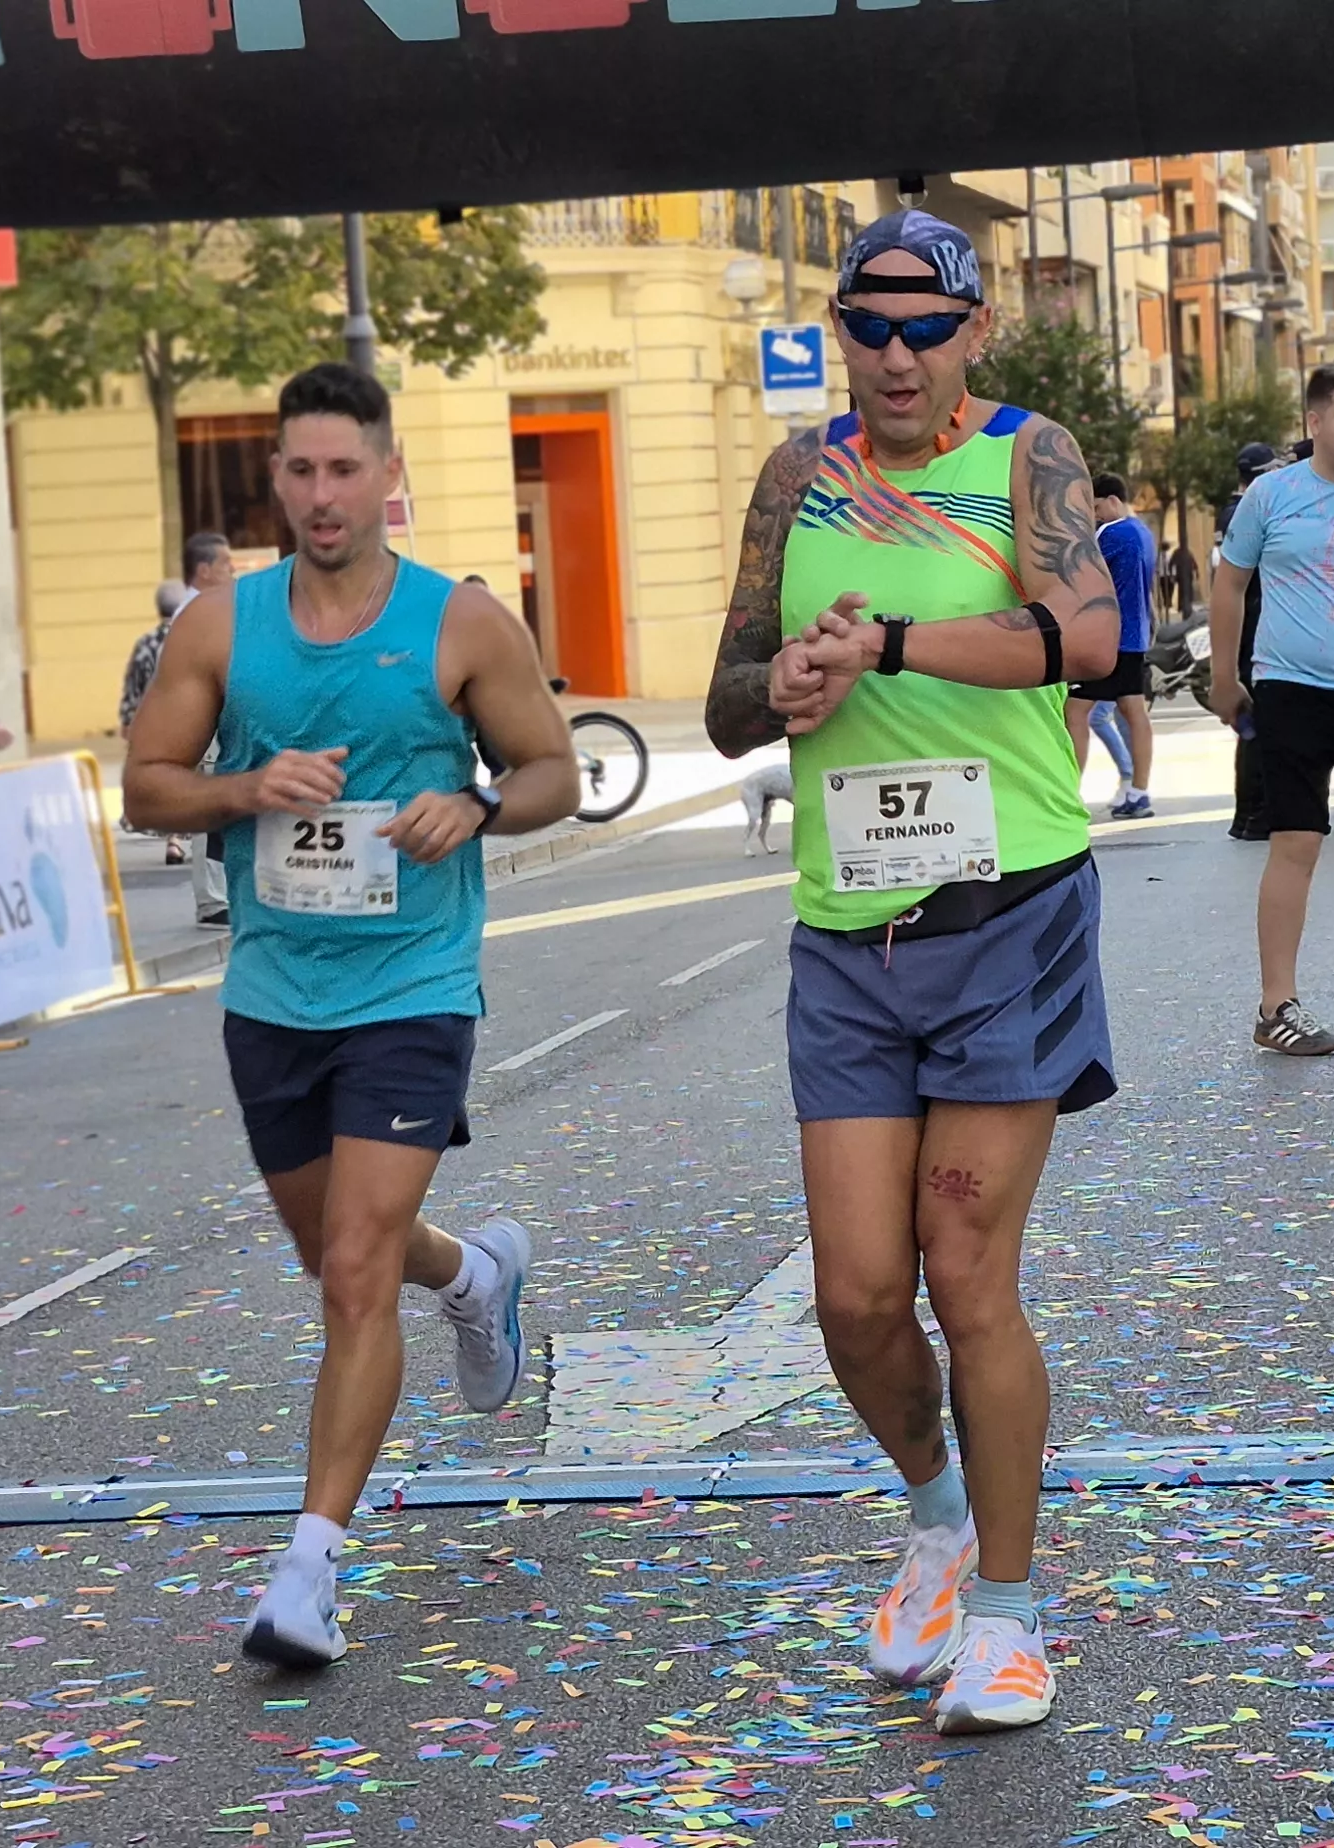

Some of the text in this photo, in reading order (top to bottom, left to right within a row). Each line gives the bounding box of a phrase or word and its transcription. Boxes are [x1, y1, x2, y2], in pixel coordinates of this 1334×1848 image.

[878, 780, 932, 819] 57
[293, 820, 345, 852] 25
[865, 821, 955, 842] FERNANDO
[285, 856, 355, 871] CRISTIAN
